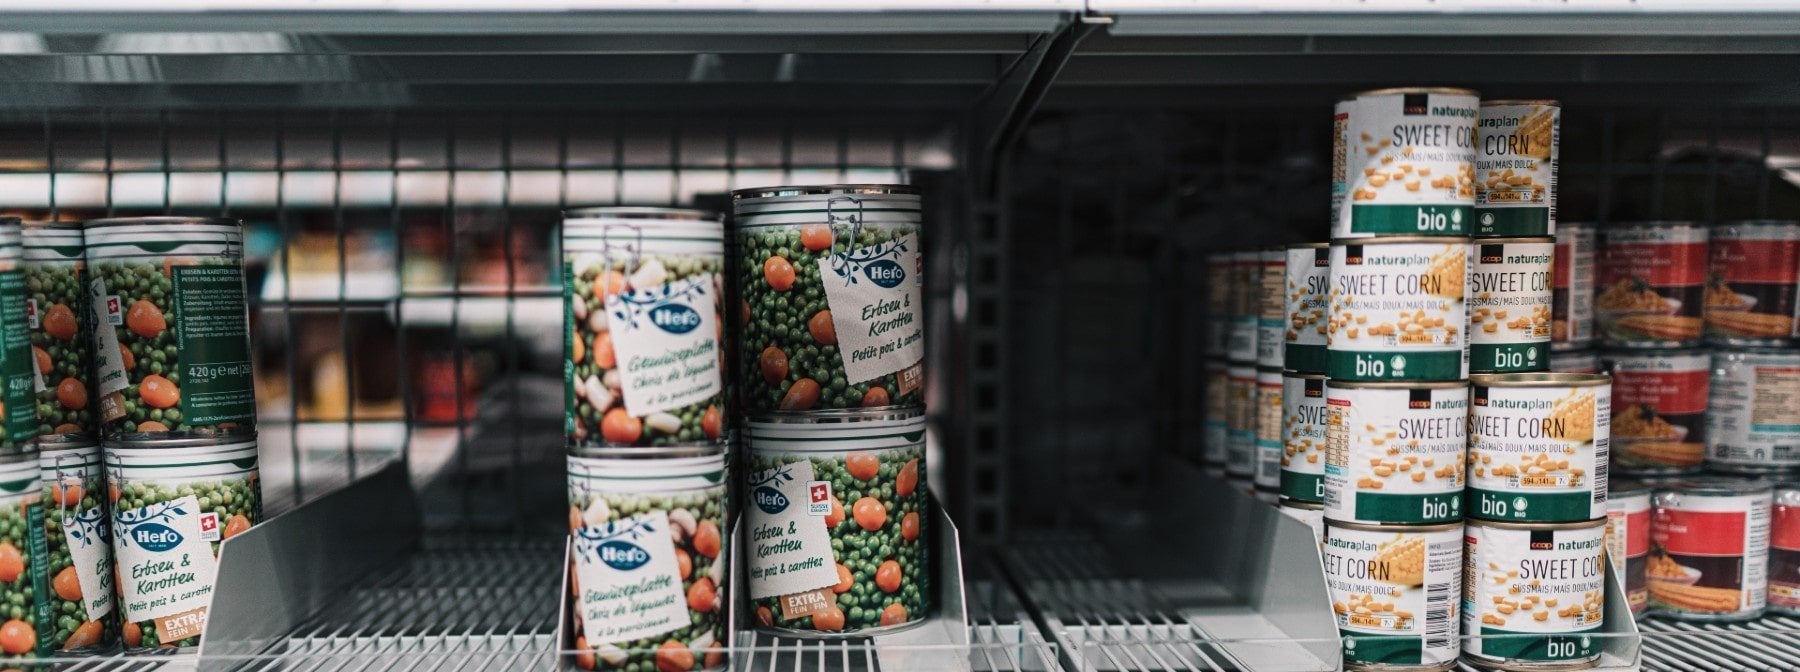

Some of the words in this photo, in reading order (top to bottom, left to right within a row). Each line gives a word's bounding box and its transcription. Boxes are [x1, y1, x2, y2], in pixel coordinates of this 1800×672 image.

[1392, 125, 1452, 149] SWEET
[1485, 134, 1530, 156] CORN
[1416, 207, 1447, 231] bio
[1367, 253, 1431, 268] naturaplan
[871, 266, 903, 280] Hero
[1472, 271, 1527, 293] SWEET
[1339, 274, 1388, 296] SWEET
[1395, 274, 1442, 296] CORN
[654, 308, 699, 326] Hero
[861, 299, 901, 321] Erbsen
[903, 293, 910, 307] &
[868, 311, 914, 337] Karotten
[852, 345, 877, 363] Petits
[878, 339, 895, 359] pois
[1494, 347, 1523, 368] bio
[189, 366, 209, 377] 420
[1355, 354, 1385, 377] bio
[1491, 399, 1553, 411] naturaplan
[1398, 417, 1452, 440] SWEET
[1469, 414, 1510, 438] SWEET
[1517, 417, 1566, 439] CORN
[756, 492, 786, 506] Hero
[1422, 498, 1448, 519] bio
[1481, 493, 1508, 517] bio
[137, 529, 178, 543] Hero
[753, 524, 784, 542] Erbsen
[787, 521, 796, 533] &
[601, 546, 647, 562] Hero
[757, 538, 803, 558] Karotten
[1329, 537, 1378, 553] naturaplan
[1531, 542, 1553, 550] coop
[132, 559, 175, 579] Erbsen
[181, 553, 191, 567] &
[764, 563, 778, 581] pois
[788, 556, 824, 571] carottes
[1347, 557, 1390, 581] CORN
[1519, 558, 1578, 580] SWEET
[136, 572, 195, 595] Karotten
[129, 600, 148, 613] Petits
[150, 595, 167, 611] pois
[788, 591, 825, 607] EXTRA
[790, 604, 808, 614] FEIN
[164, 611, 206, 631] EXTRA
[168, 626, 189, 639] FEIN
[1547, 634, 1576, 658] bio
